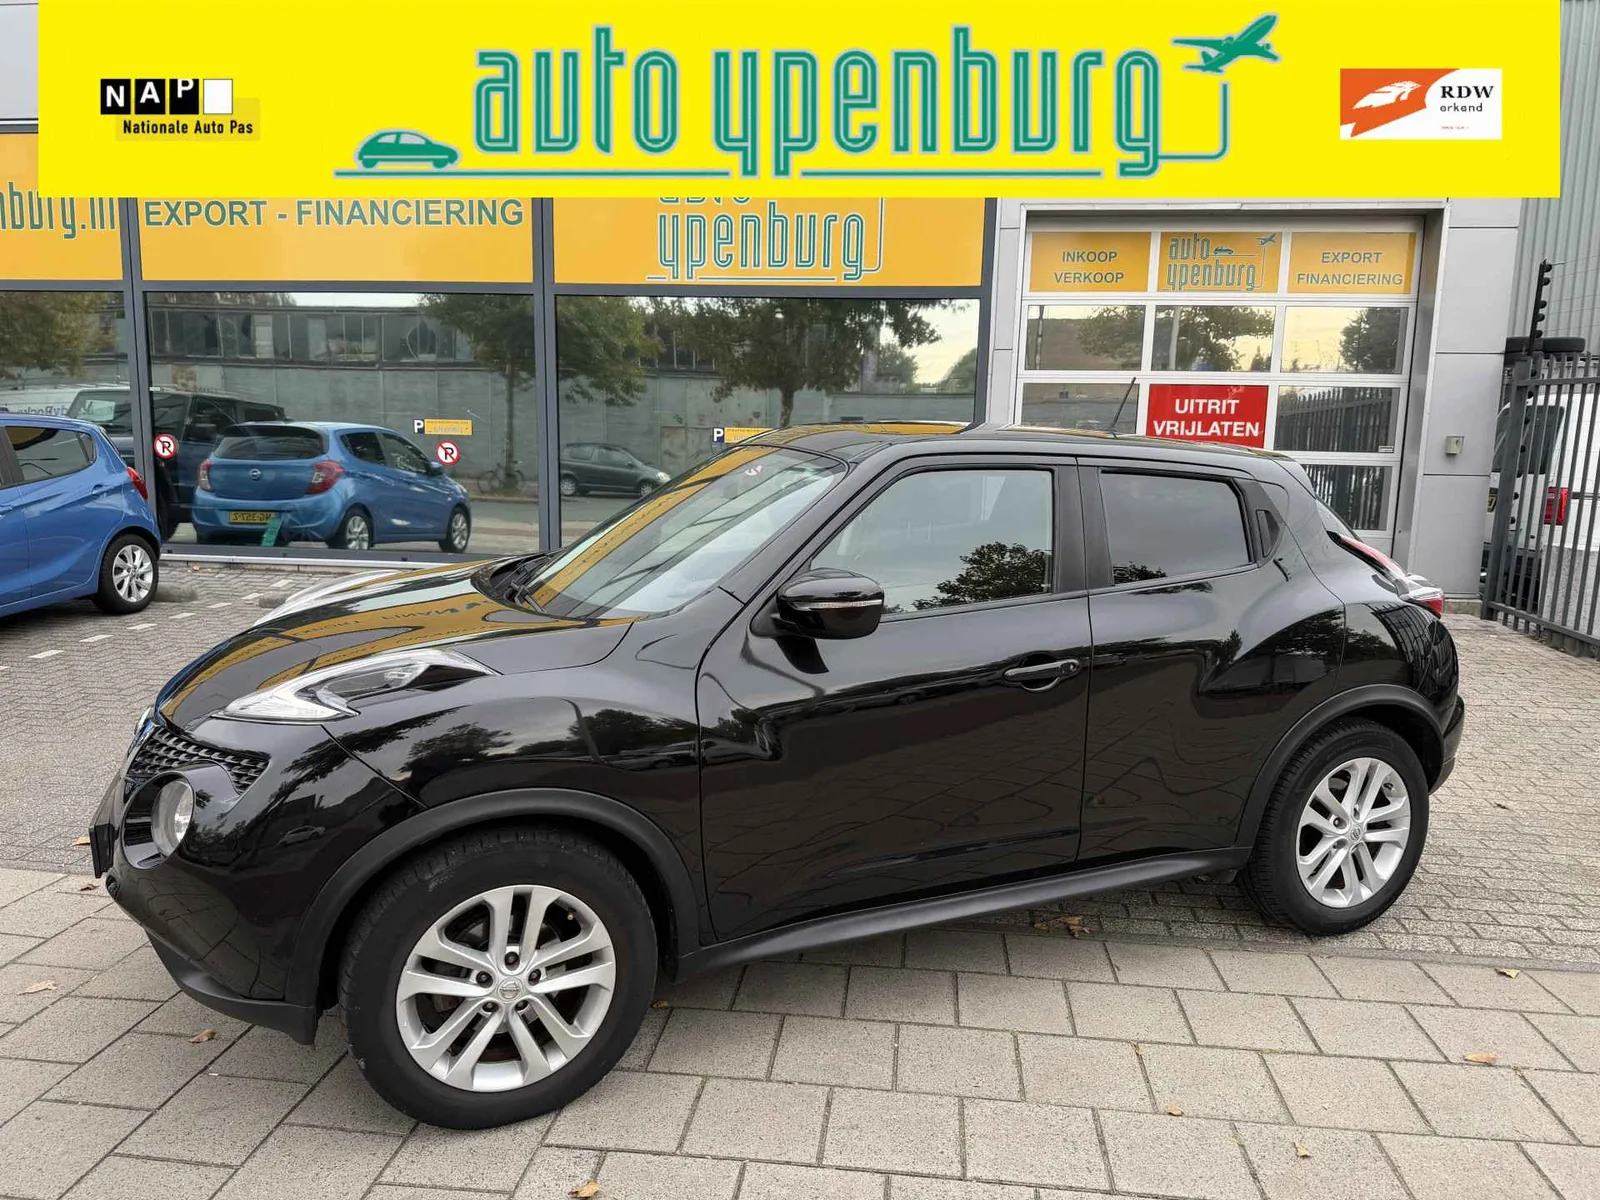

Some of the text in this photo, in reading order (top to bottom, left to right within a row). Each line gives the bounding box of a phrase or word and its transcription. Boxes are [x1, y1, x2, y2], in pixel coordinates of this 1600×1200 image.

[144, 200, 268, 227] EXPORT
[296, 199, 524, 227] FINANCIERING
[658, 201, 864, 281] ypenburg
[1169, 232, 1211, 261] auto
[1062, 251, 1118, 263] INKOOP
[1321, 251, 1383, 264] EXPORT
[1054, 271, 1125, 284] VERKOOP
[1167, 258, 1257, 292] ypenburg
[1296, 272, 1404, 286] FINANCIERING
[1174, 398, 1241, 415] UITRIT
[413, 419, 424, 434] P
[1153, 419, 1260, 437] VRIJLATEN
[713, 428, 724, 442] P
